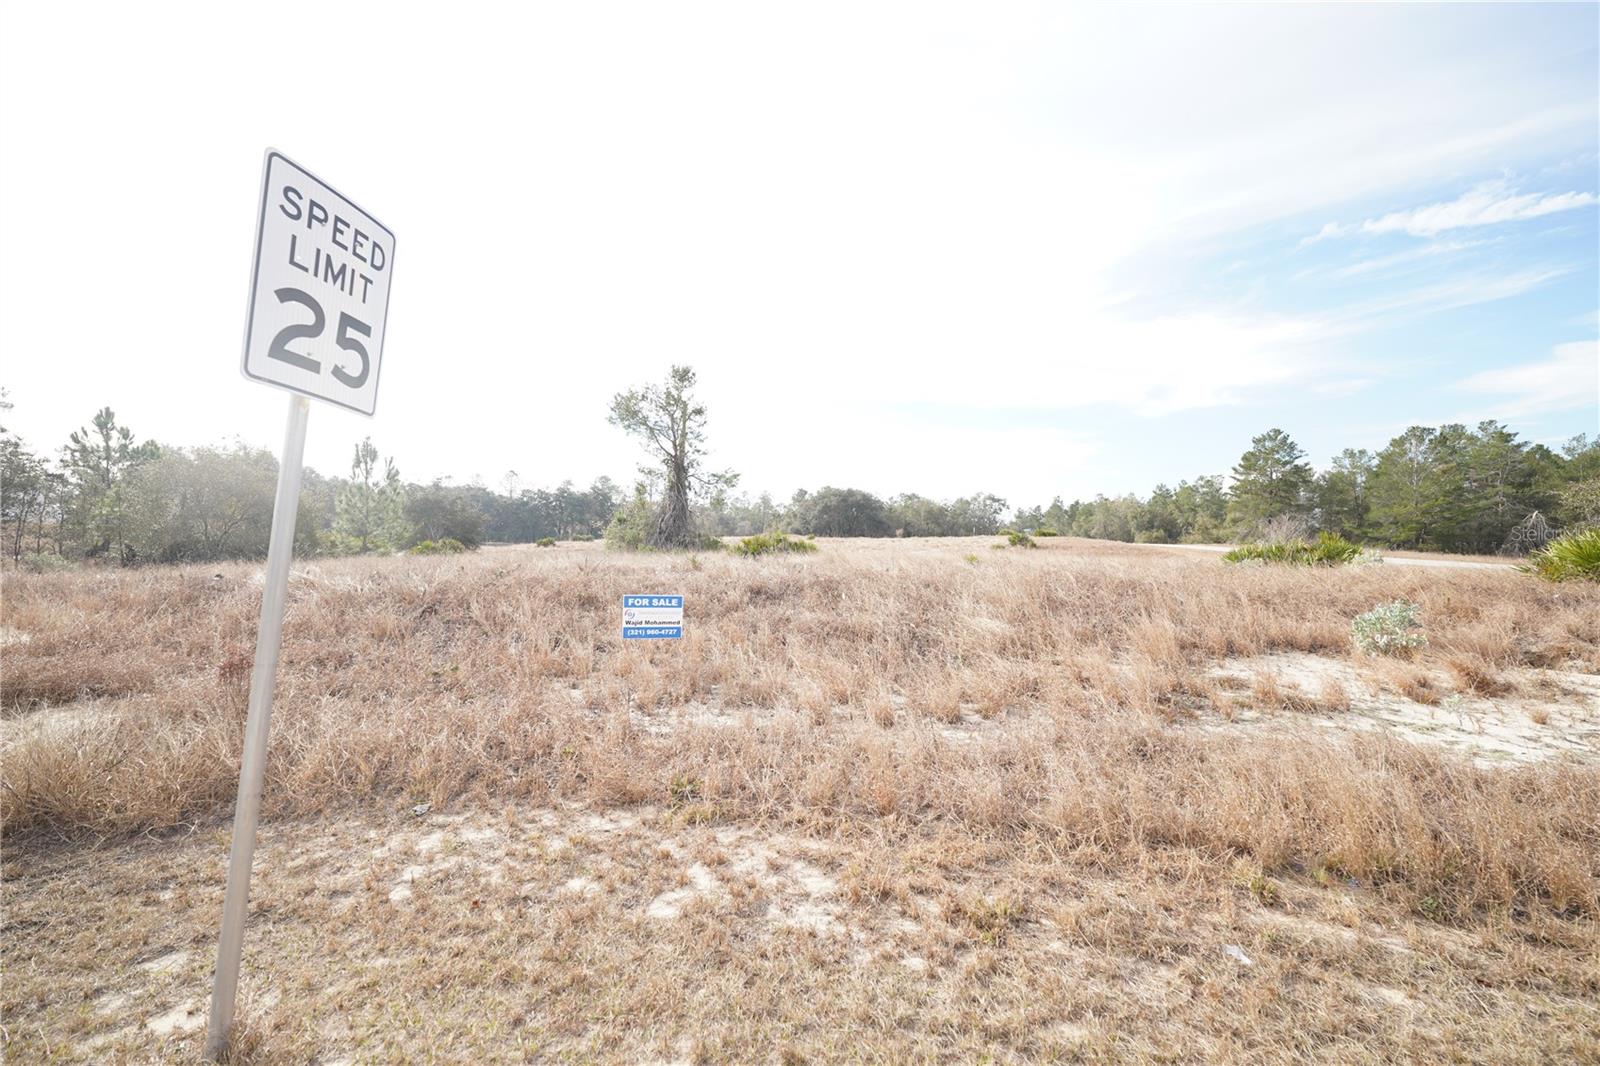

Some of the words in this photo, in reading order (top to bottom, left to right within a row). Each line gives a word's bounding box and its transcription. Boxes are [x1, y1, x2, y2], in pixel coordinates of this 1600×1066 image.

[278, 185, 386, 272] SPEED
[288, 234, 374, 304] LIMIT
[267, 287, 373, 390] 25
[628, 598, 649, 606] FOR
[652, 598, 679, 606] SALE
